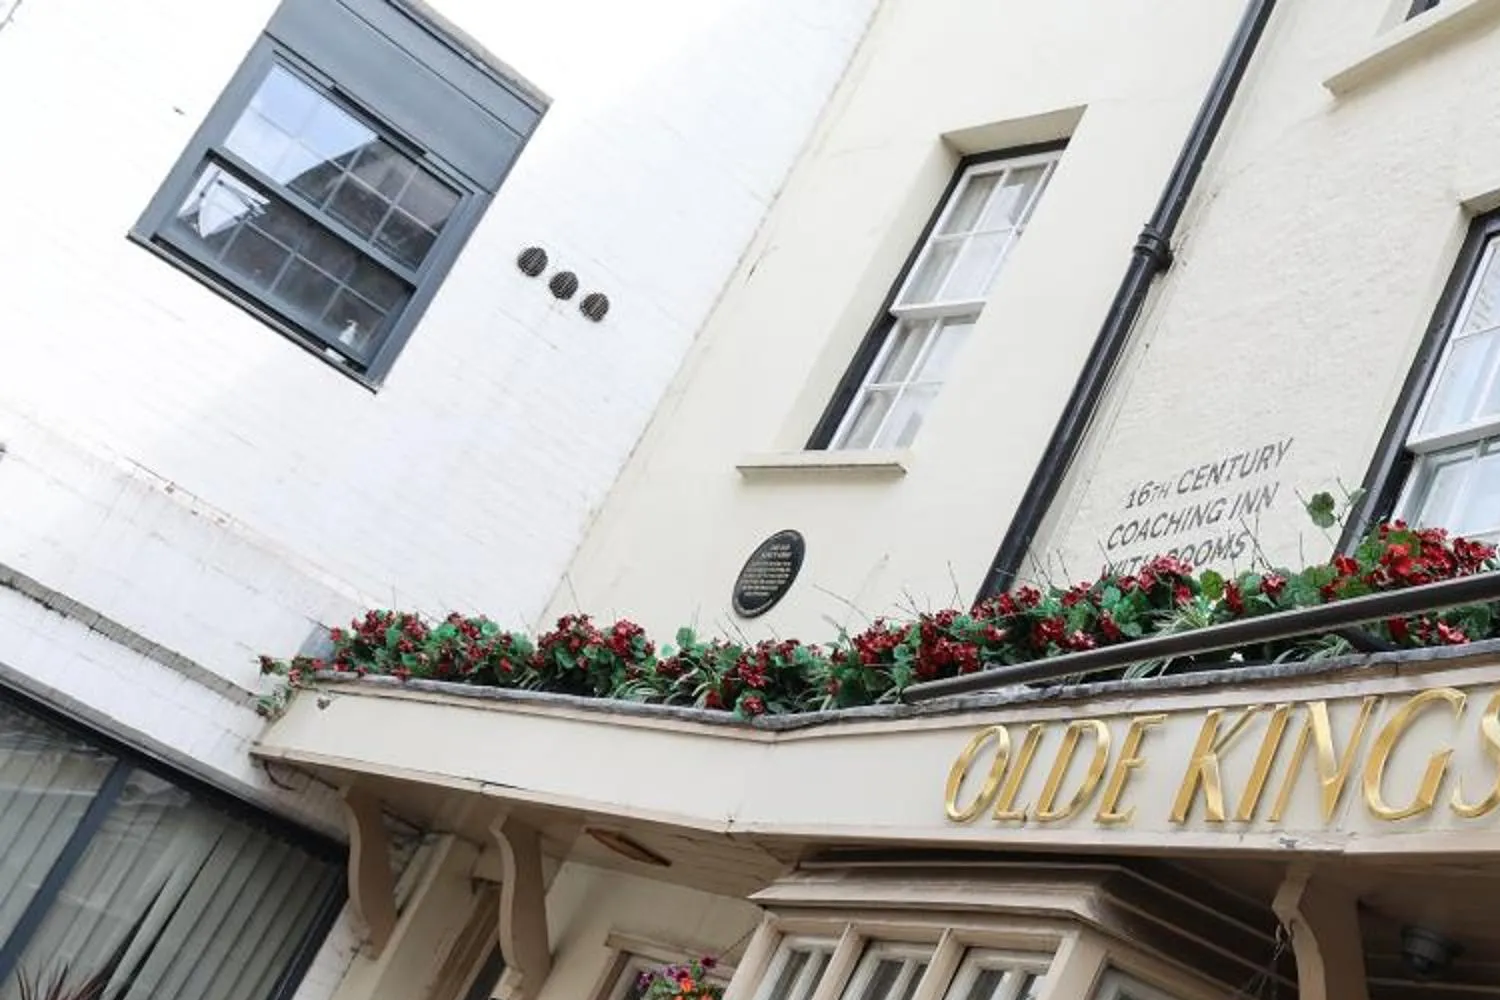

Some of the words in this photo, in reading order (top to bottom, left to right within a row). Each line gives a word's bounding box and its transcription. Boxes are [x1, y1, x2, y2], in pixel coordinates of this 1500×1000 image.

[1126, 480, 1172, 509] 16TH
[1177, 437, 1294, 494] CENTURY
[1107, 497, 1228, 550] COACHING
[1229, 481, 1280, 520] INN
[944, 714, 1168, 824] OLDE
